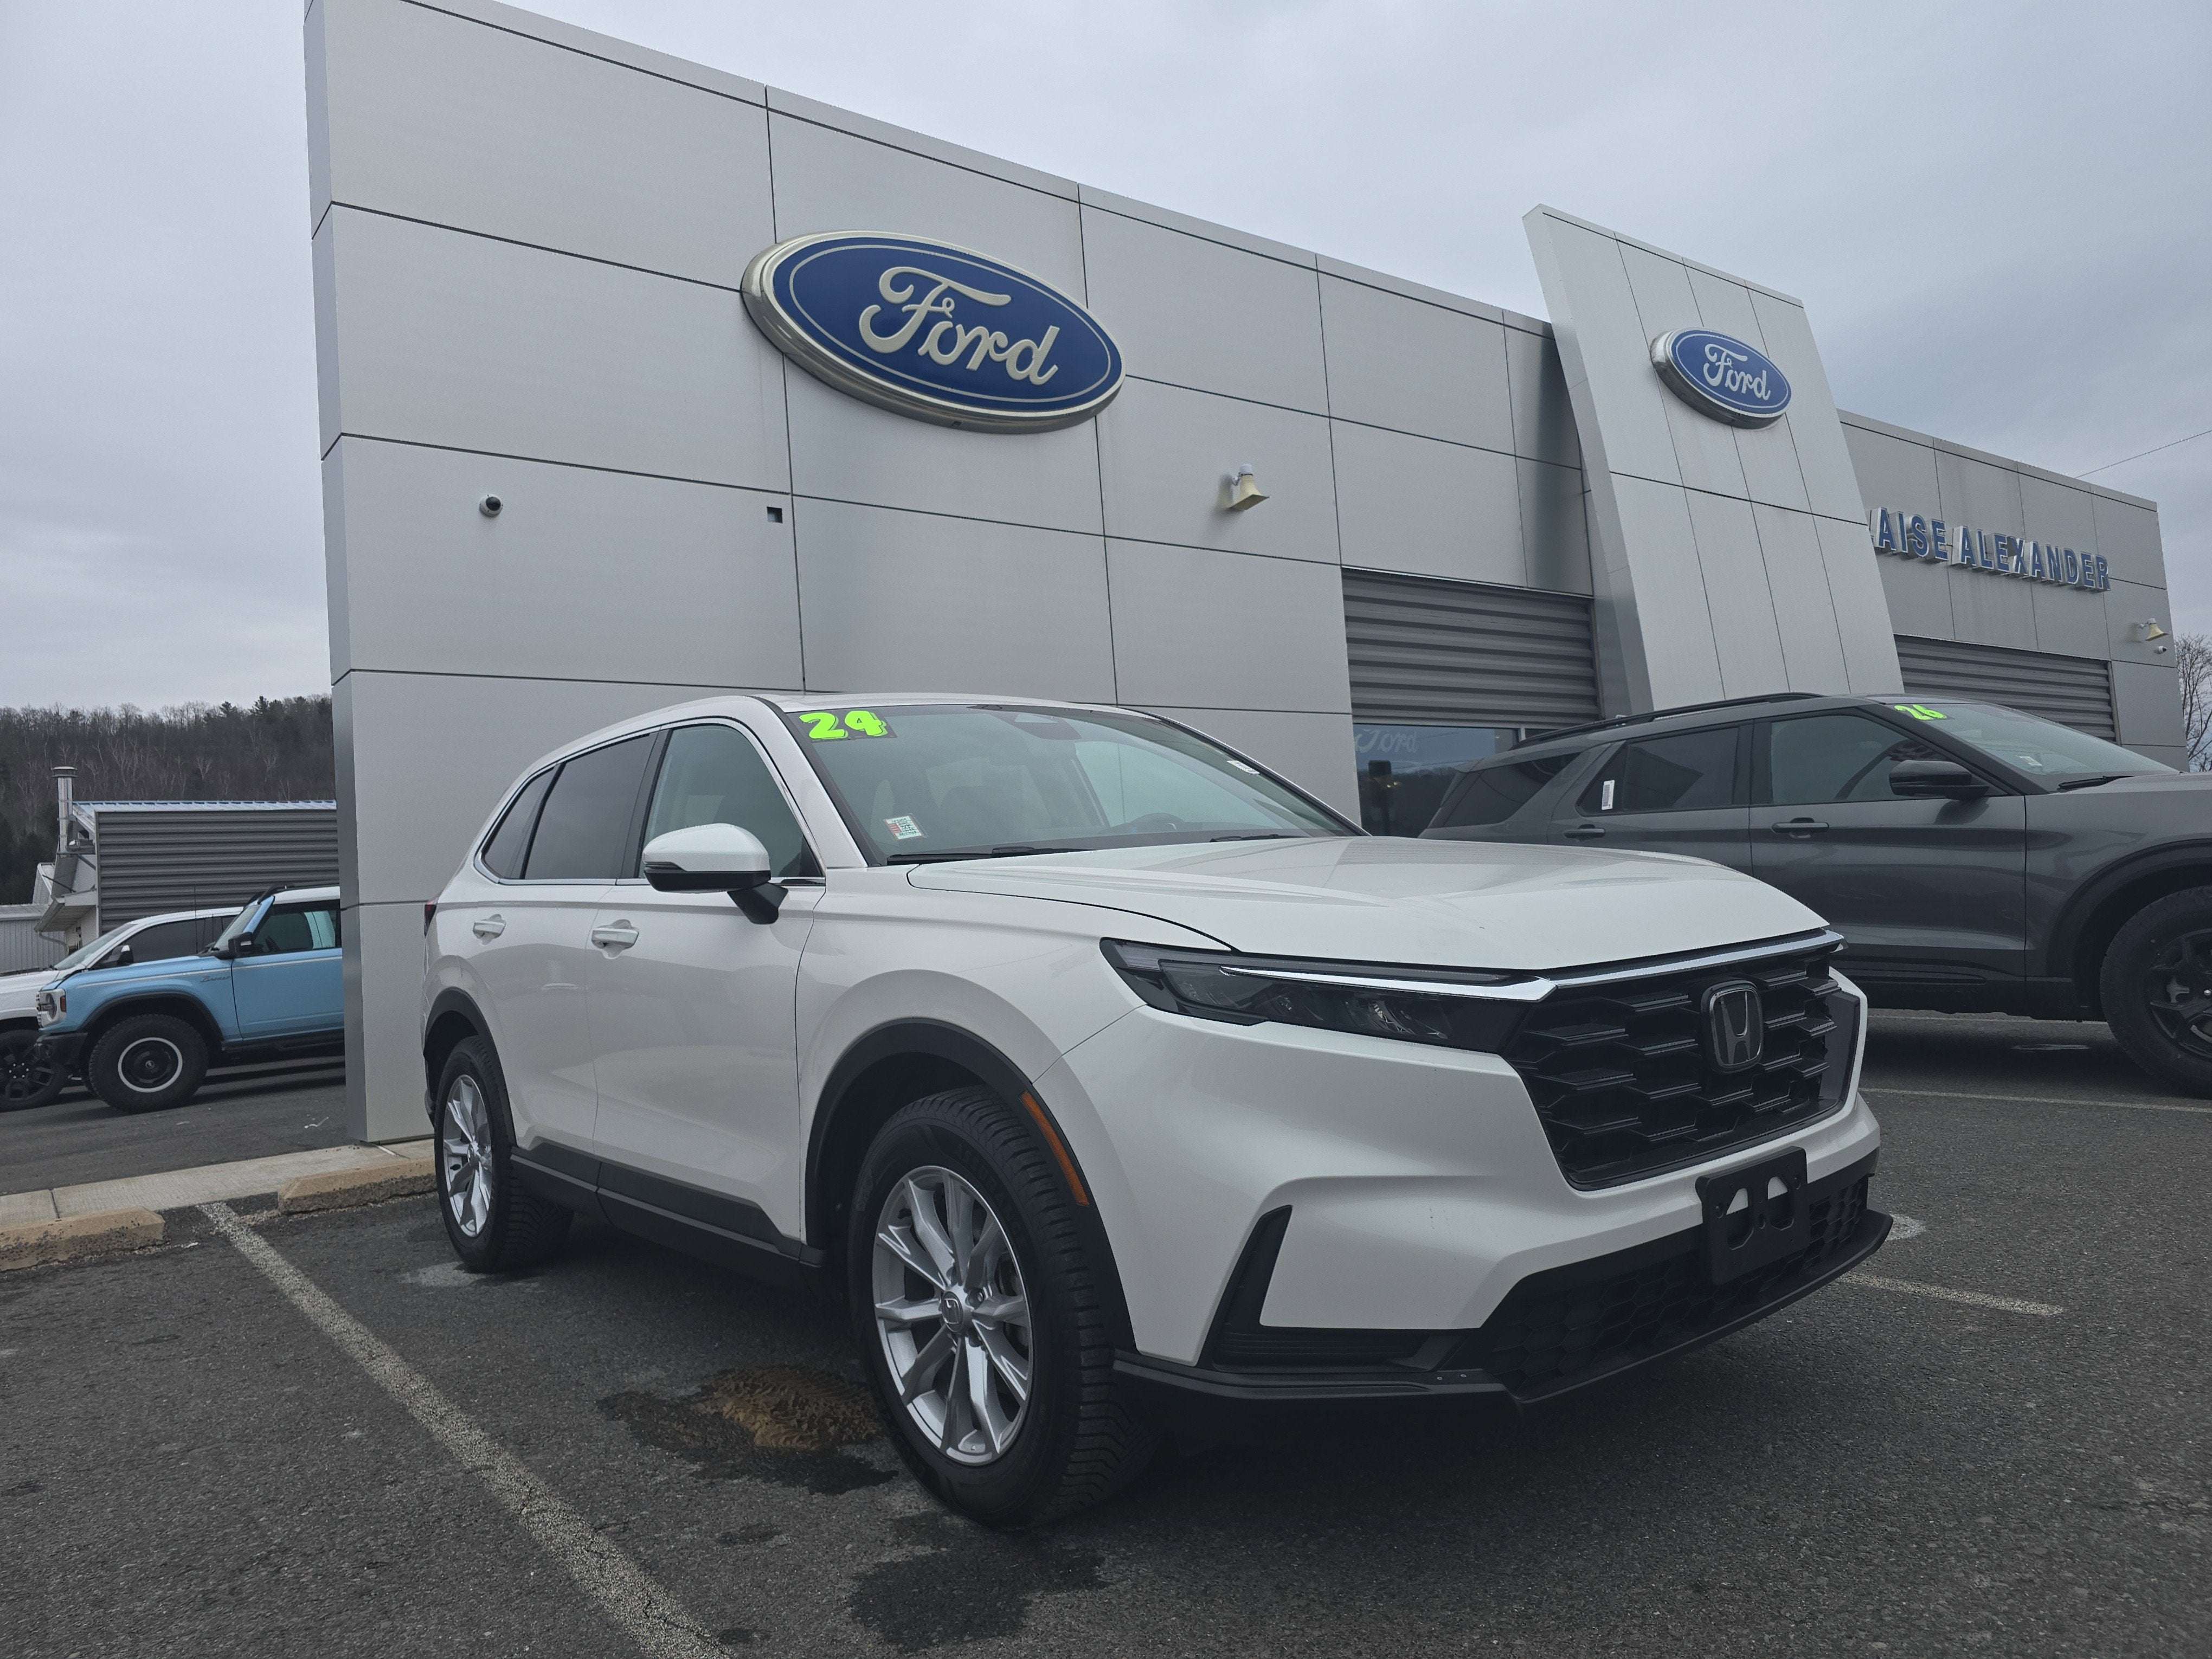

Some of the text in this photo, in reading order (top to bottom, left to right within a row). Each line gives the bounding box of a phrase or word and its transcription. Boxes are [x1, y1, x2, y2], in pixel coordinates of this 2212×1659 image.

[859, 266, 1059, 385] Ford
[1703, 344, 1771, 401] Ford
[1872, 507, 2111, 591] AISE ALEXANDER
[799, 711, 888, 740] 24
[1894, 704, 1947, 721] 26
